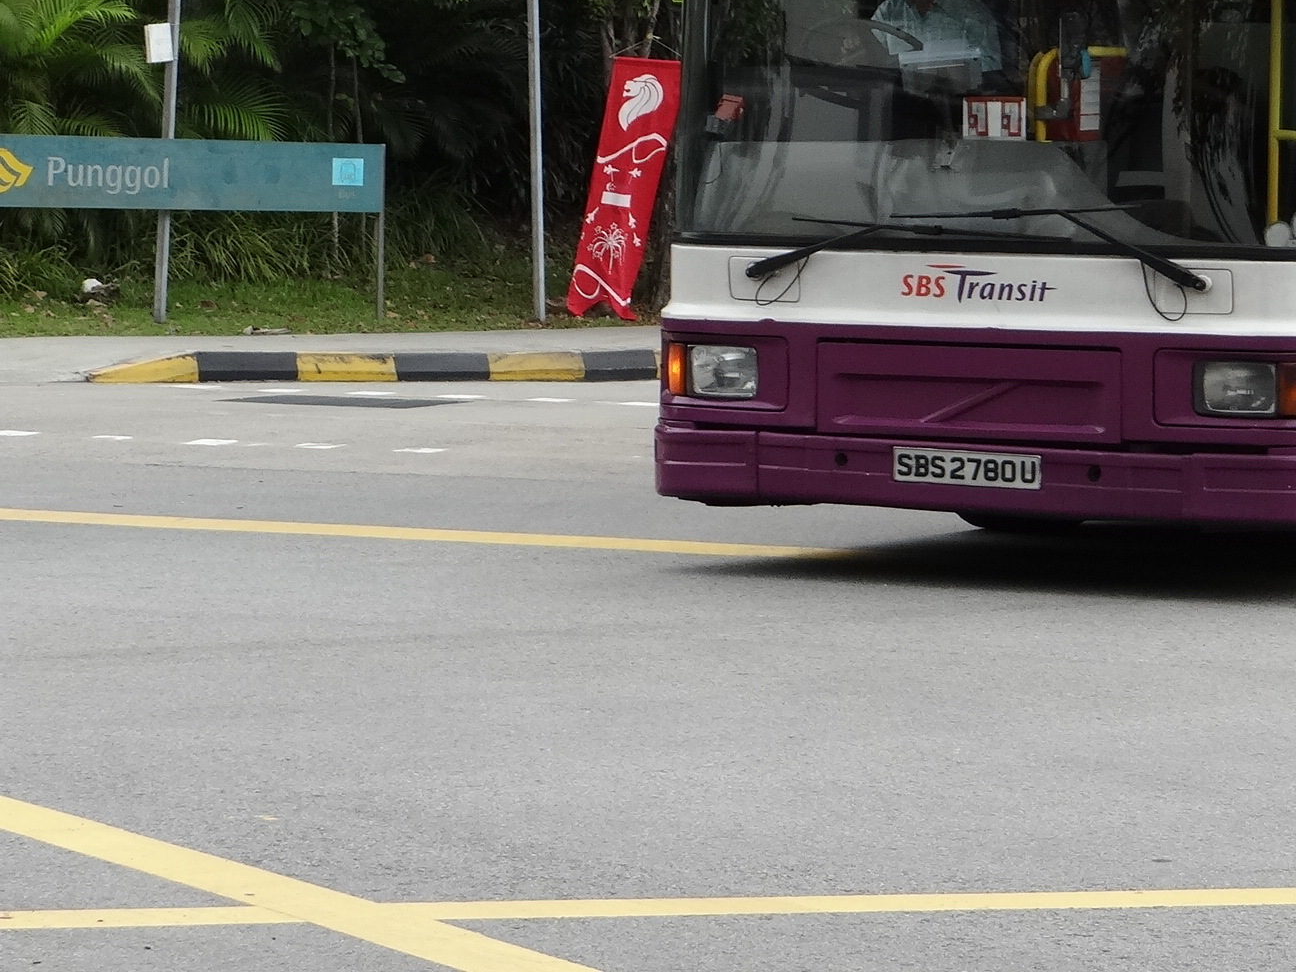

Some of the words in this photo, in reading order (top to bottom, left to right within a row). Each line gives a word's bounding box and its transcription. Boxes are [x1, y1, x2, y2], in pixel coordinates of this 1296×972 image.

[46, 155, 170, 195] Punggol
[901, 273, 946, 298] SBS
[942, 270, 1058, 303] Transit
[896, 453, 1037, 484] SBS2780U
